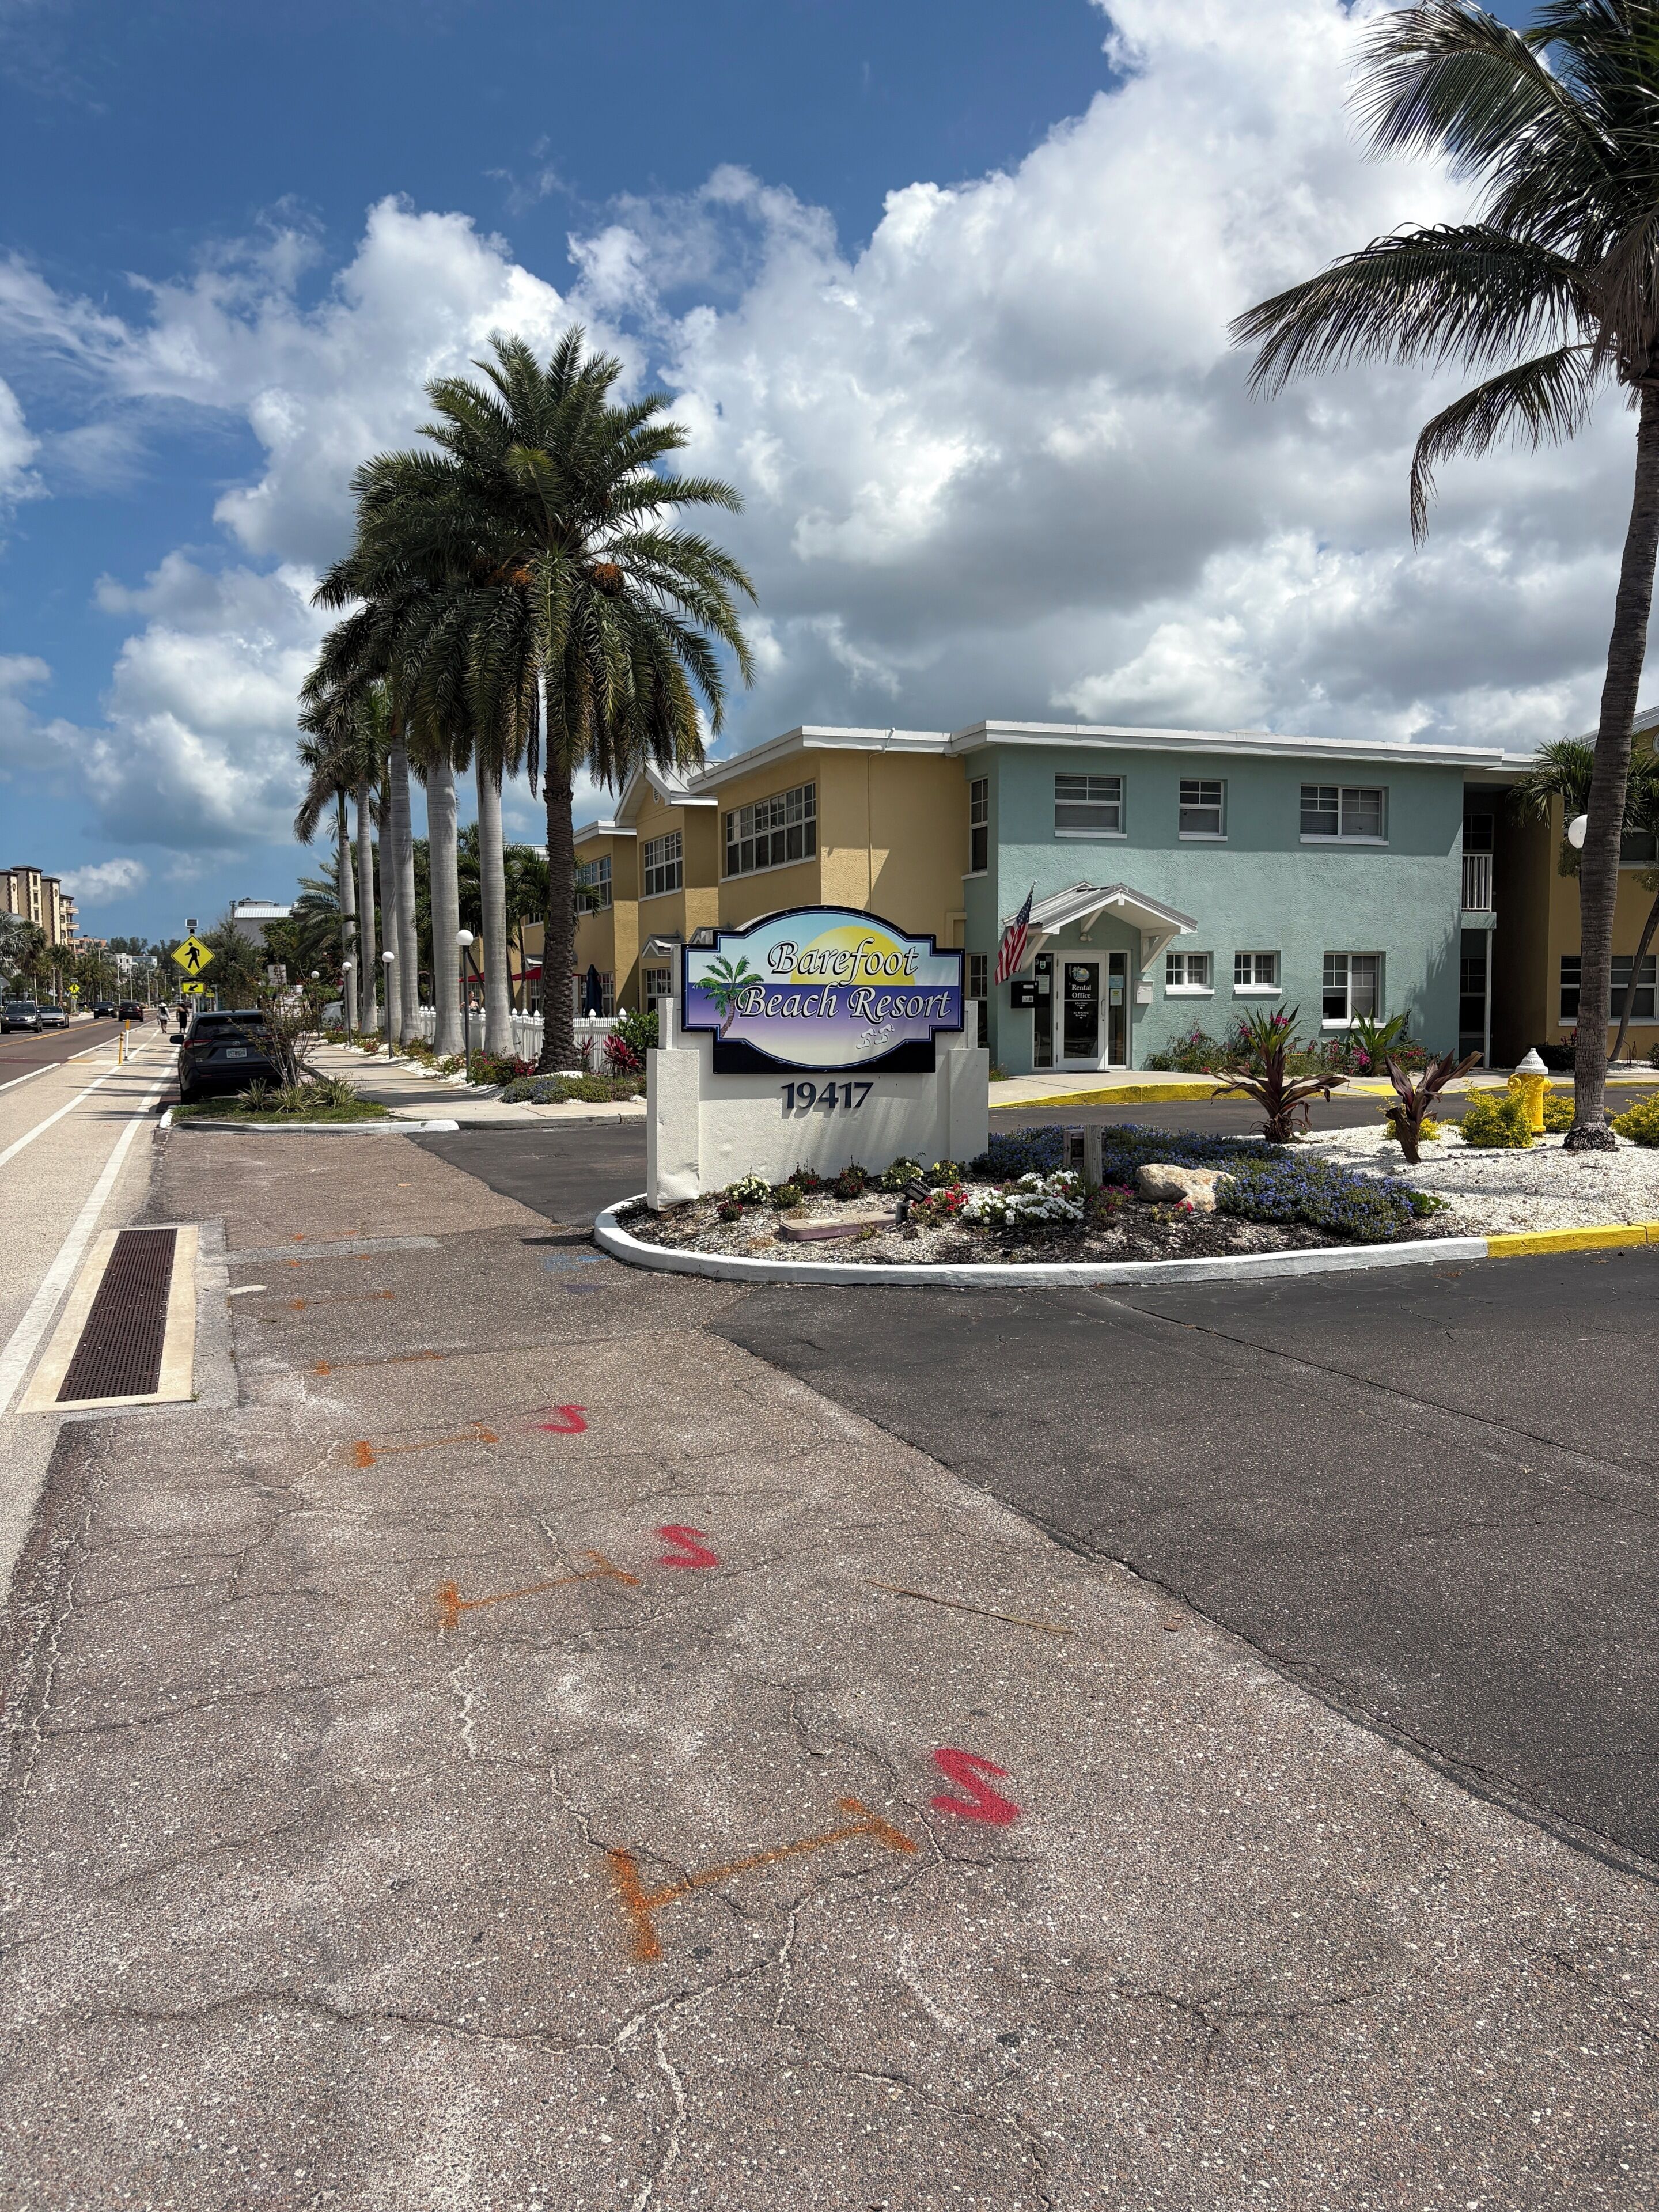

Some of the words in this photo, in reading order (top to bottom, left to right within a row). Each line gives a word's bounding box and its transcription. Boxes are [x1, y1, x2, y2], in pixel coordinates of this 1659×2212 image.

[768, 937, 918, 987] Barefoot
[736, 982, 839, 1019] Beach
[848, 987, 952, 1024] Resort
[781, 1082, 874, 1109] 19417
[658, 1524, 718, 1568] S
[931, 1748, 1021, 1825] S
